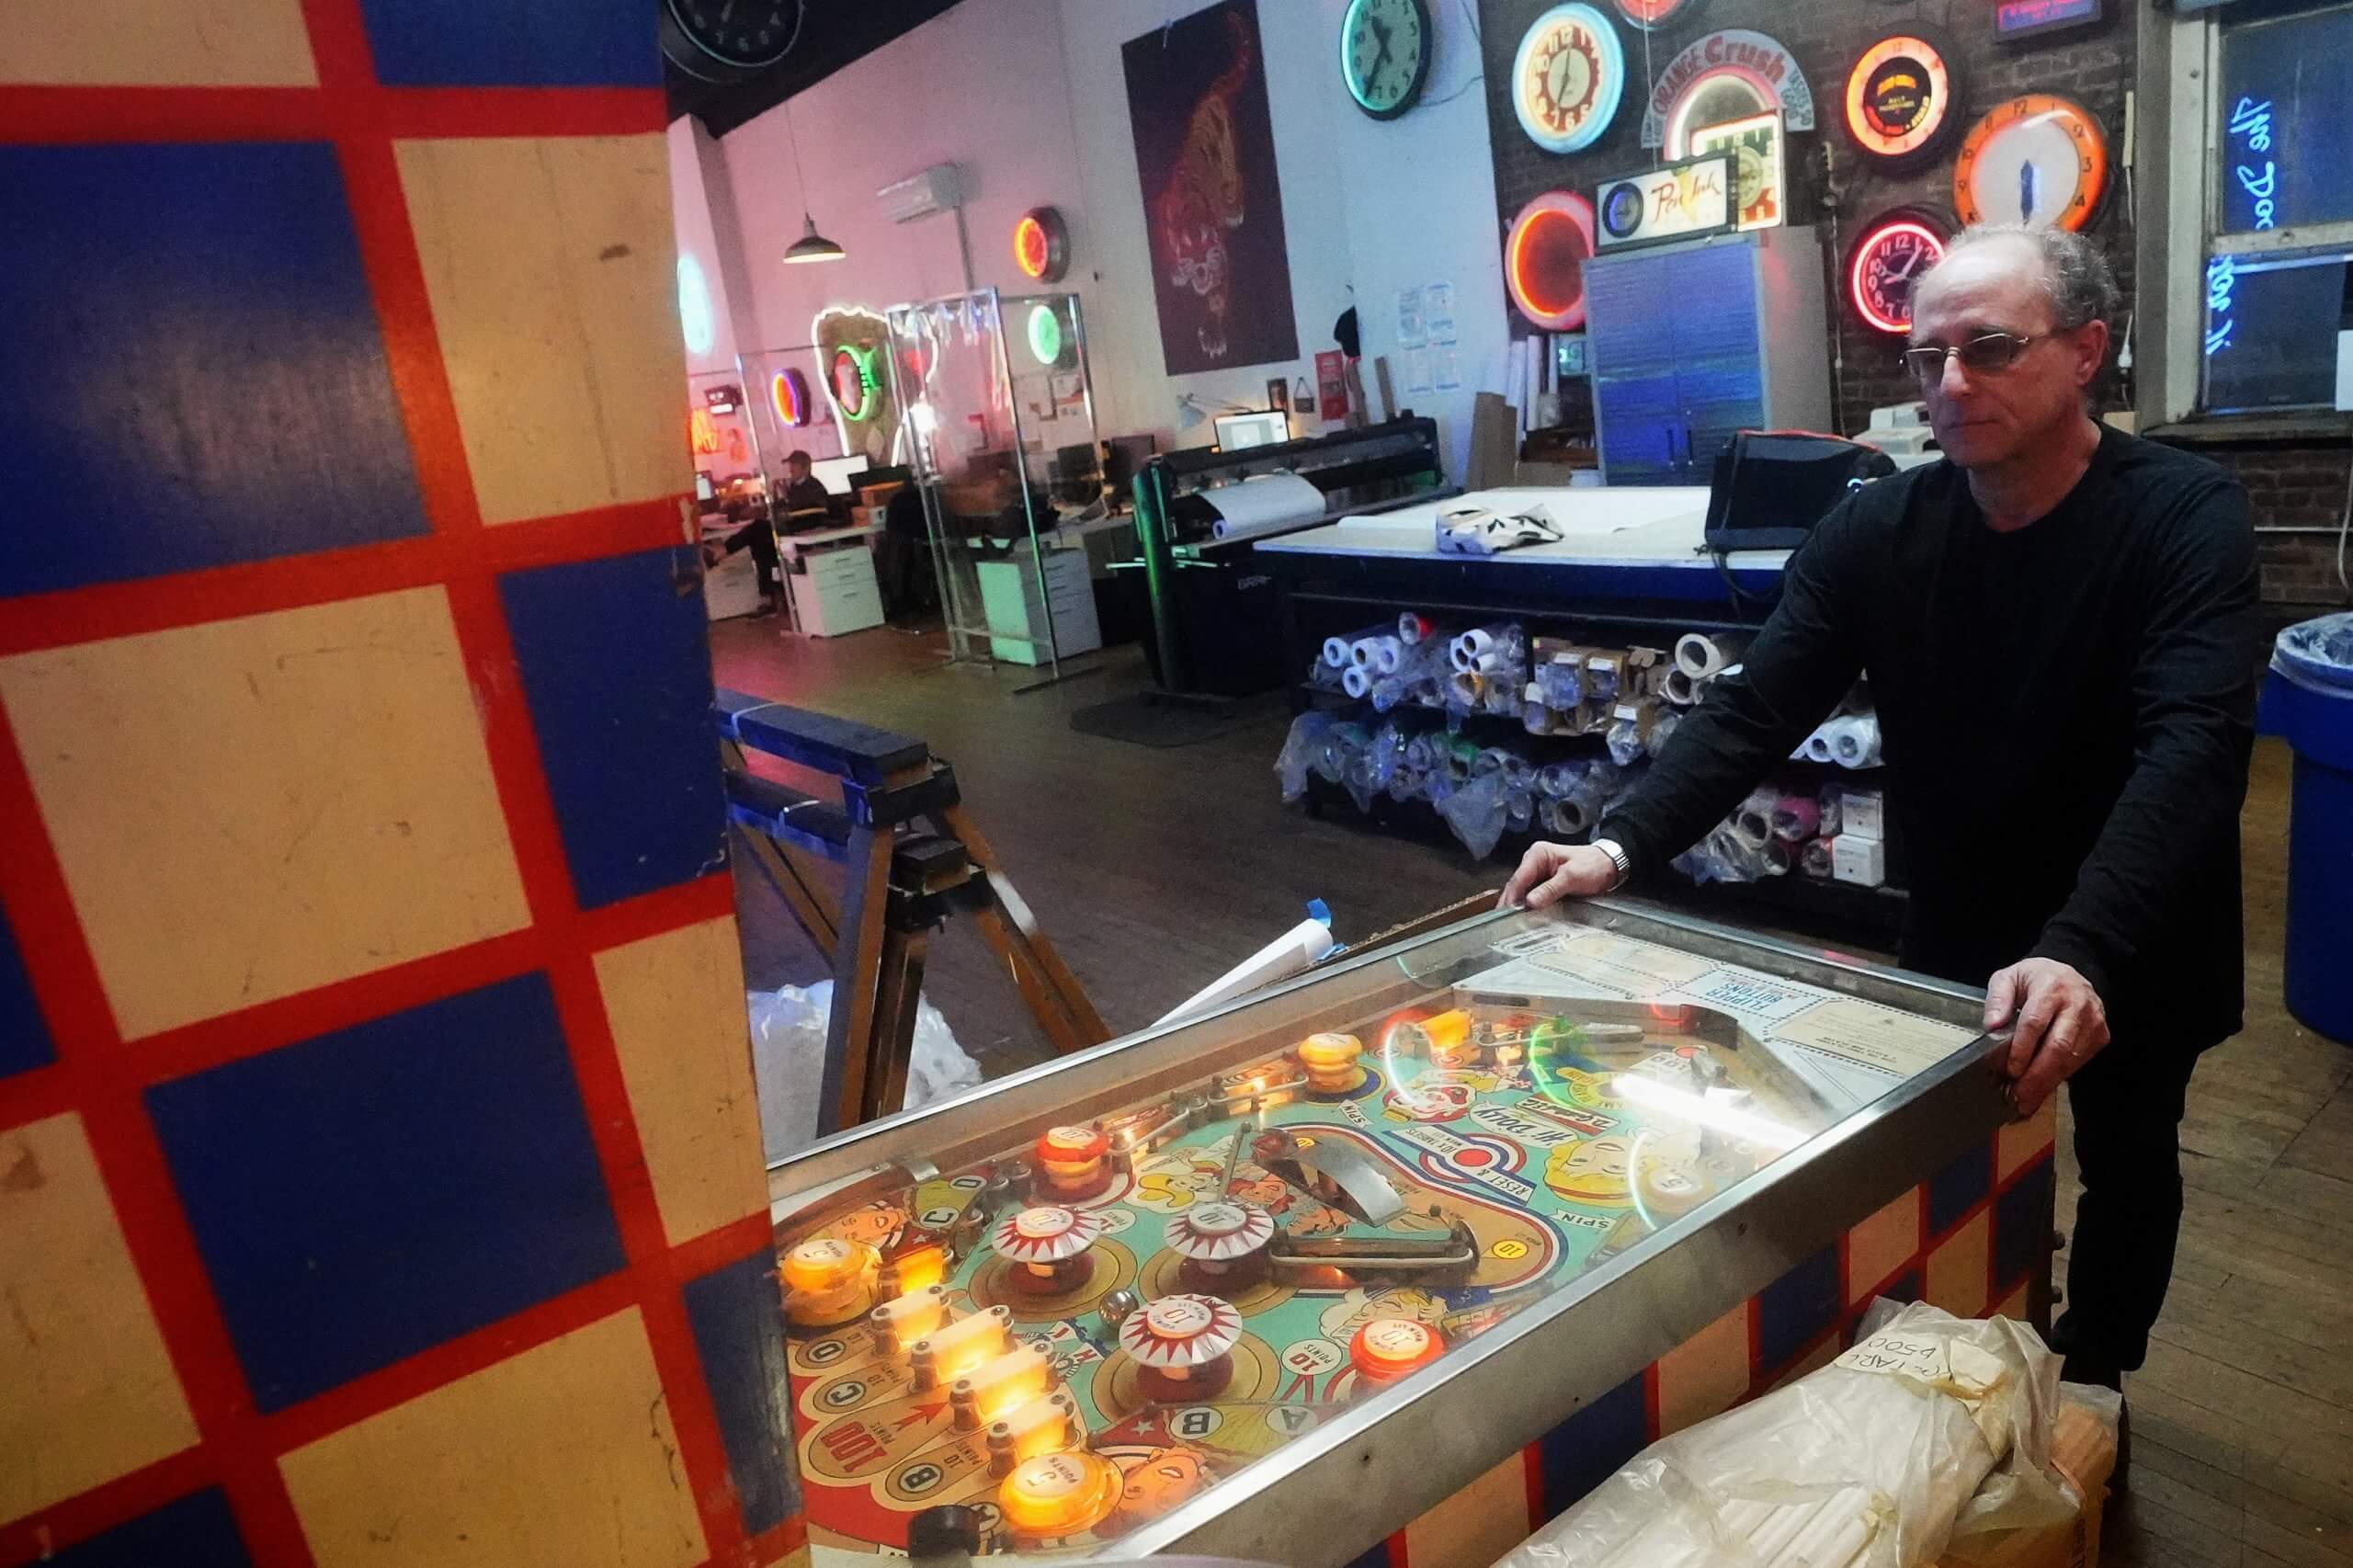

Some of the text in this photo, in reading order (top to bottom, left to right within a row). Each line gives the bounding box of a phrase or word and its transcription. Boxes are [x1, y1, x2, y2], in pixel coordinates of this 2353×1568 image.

[1560, 26, 1574, 44] 12
[1580, 28, 1586, 46] 1
[1705, 36, 1786, 85] Crush
[2014, 99, 2028, 114] 12
[1552, 108, 1560, 127] 7
[2074, 124, 2085, 139] 2
[2083, 156, 2092, 173] 3
[2075, 194, 2086, 207] 4
[1881, 242, 1892, 256] 11
[1895, 233, 1910, 249] 12
[1925, 245, 1938, 261] 2
[1868, 275, 1878, 291] 9
[1875, 290, 1884, 308] 8
[1886, 302, 1894, 318] 7
[1706, 988, 1770, 1011] FLIPPER
[1720, 983, 1784, 1003] BUTTONS
[1342, 1104, 1367, 1125] SPIN
[952, 1178, 982, 1188] D
[1476, 1167, 1530, 1196] RESET &
[924, 1210, 954, 1223] C
[1198, 1211, 1226, 1225] 10
[1562, 1212, 1608, 1230] SPIN
[1498, 1244, 1518, 1256] 10
[1164, 1309, 1194, 1324] 10
[1381, 1330, 1411, 1346] 10
[813, 1342, 842, 1360] D
[1303, 1343, 1336, 1365] POINTS
[1290, 1352, 1321, 1372] 10
[867, 1374, 887, 1387] 10
[830, 1384, 862, 1403] C
[1181, 1412, 1211, 1436] B
[1279, 1407, 1309, 1431] A
[870, 1420, 896, 1446] POINTS
[820, 1420, 889, 1473] 100
[956, 1440, 983, 1466] POINTS
[943, 1453, 965, 1469] 10
[1049, 1456, 1080, 1484] POINTS
[904, 1466, 938, 1490] B
[1026, 1471, 1057, 1487] 5
